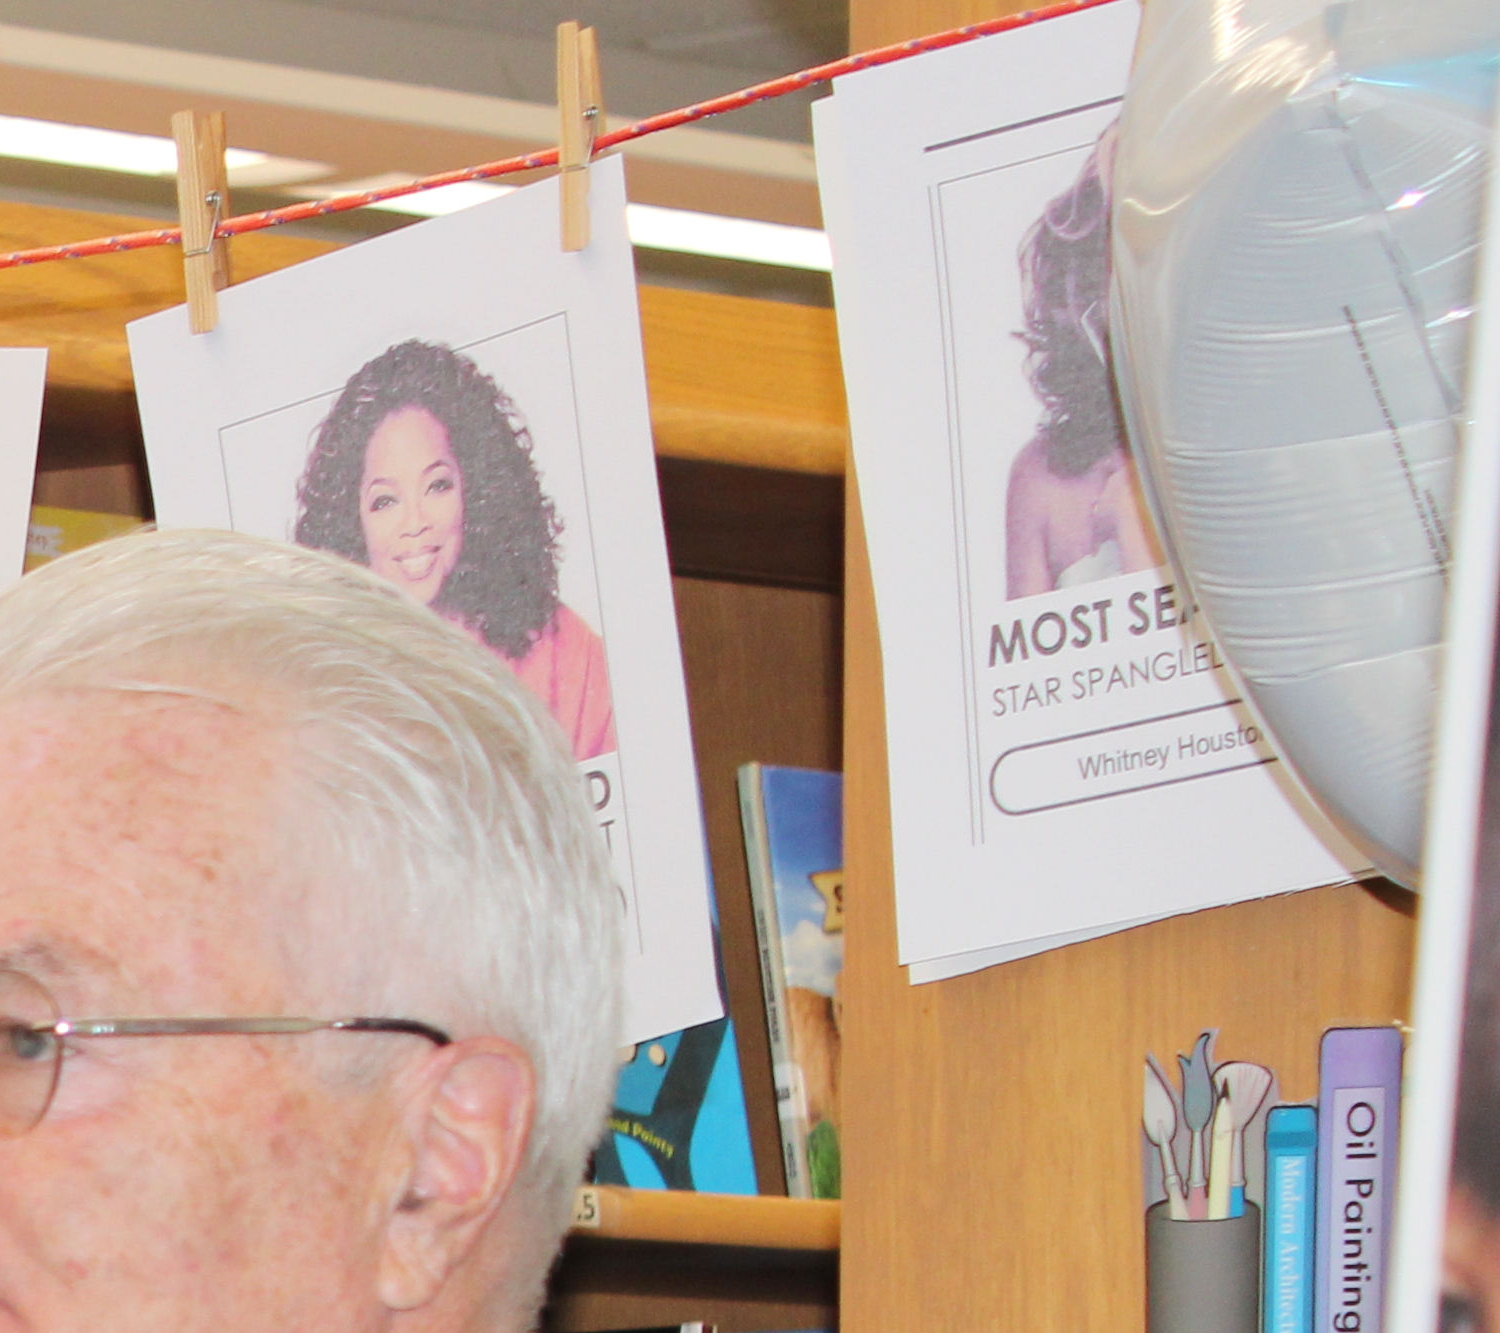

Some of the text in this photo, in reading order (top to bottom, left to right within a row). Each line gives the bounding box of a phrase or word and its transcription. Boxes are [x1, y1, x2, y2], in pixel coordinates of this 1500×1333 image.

[987, 600, 1113, 670] MOST
[991, 676, 1063, 718] STAR
[1077, 741, 1172, 782] Whitney
[1346, 1101, 1377, 1161] Oil
[1277, 1157, 1301, 1237] Modern
